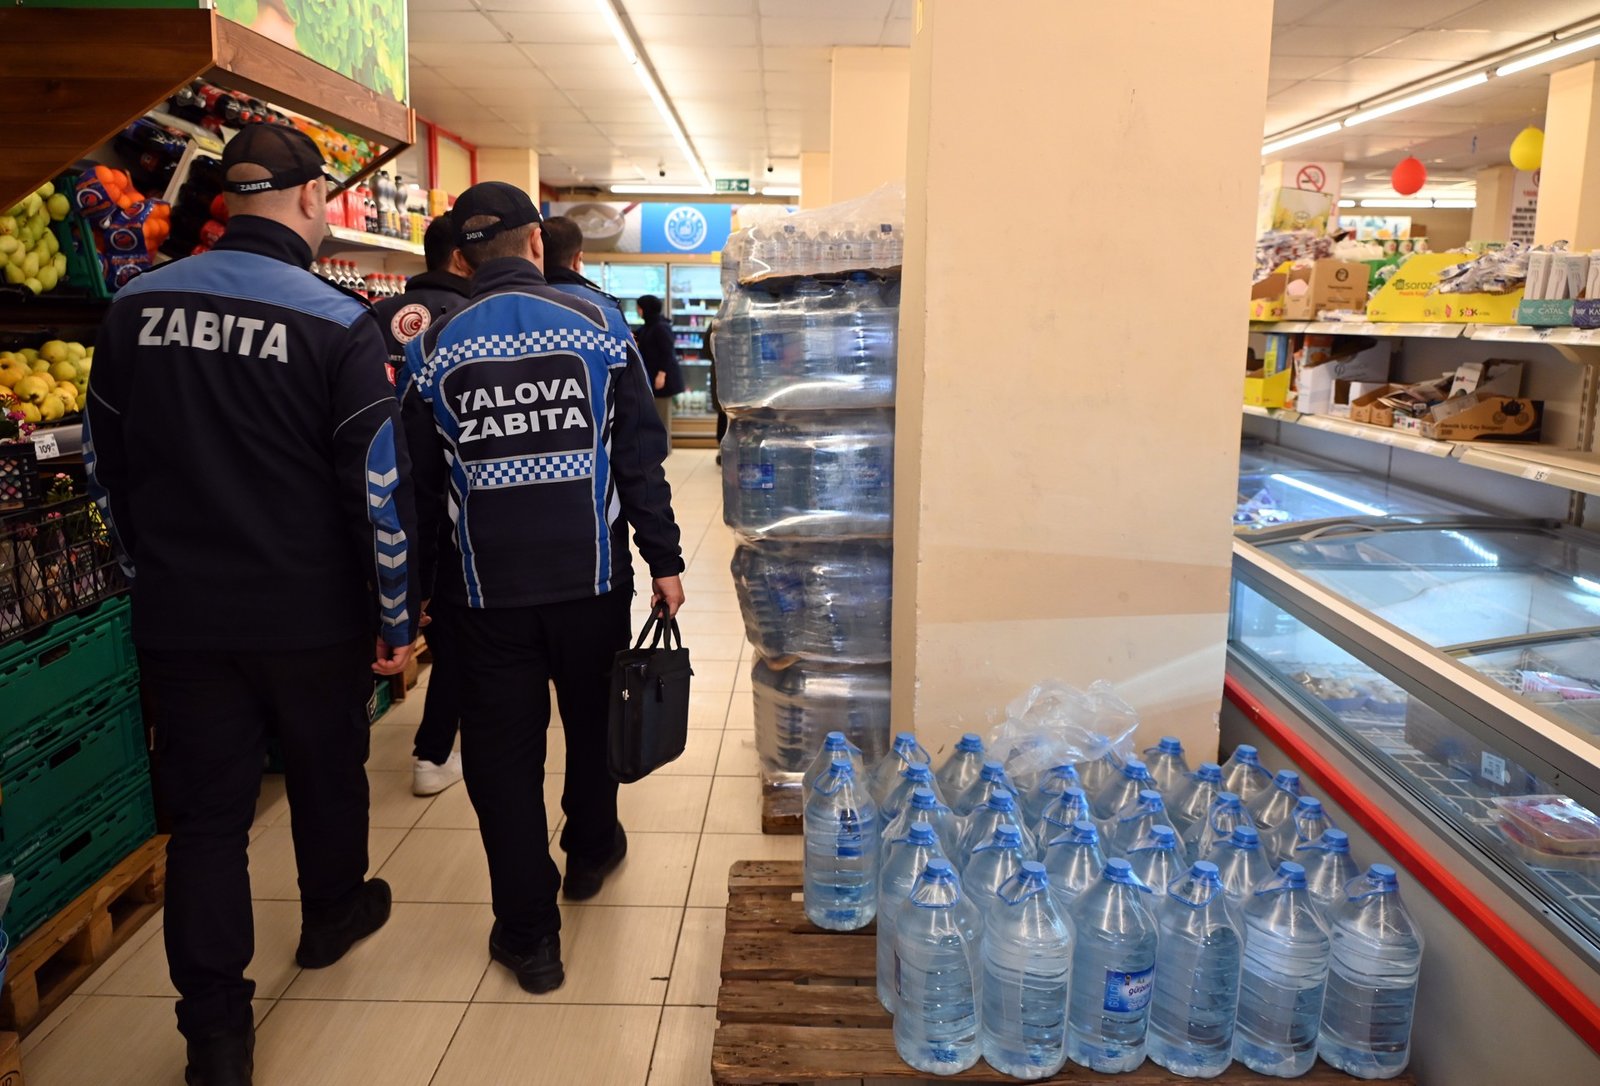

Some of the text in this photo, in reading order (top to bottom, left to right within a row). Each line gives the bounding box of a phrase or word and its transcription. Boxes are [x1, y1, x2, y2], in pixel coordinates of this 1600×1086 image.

[240, 181, 272, 192] ZABITA
[138, 307, 288, 363] ZABITA
[456, 378, 585, 414] YALOVA
[458, 406, 588, 444] ZABITA
